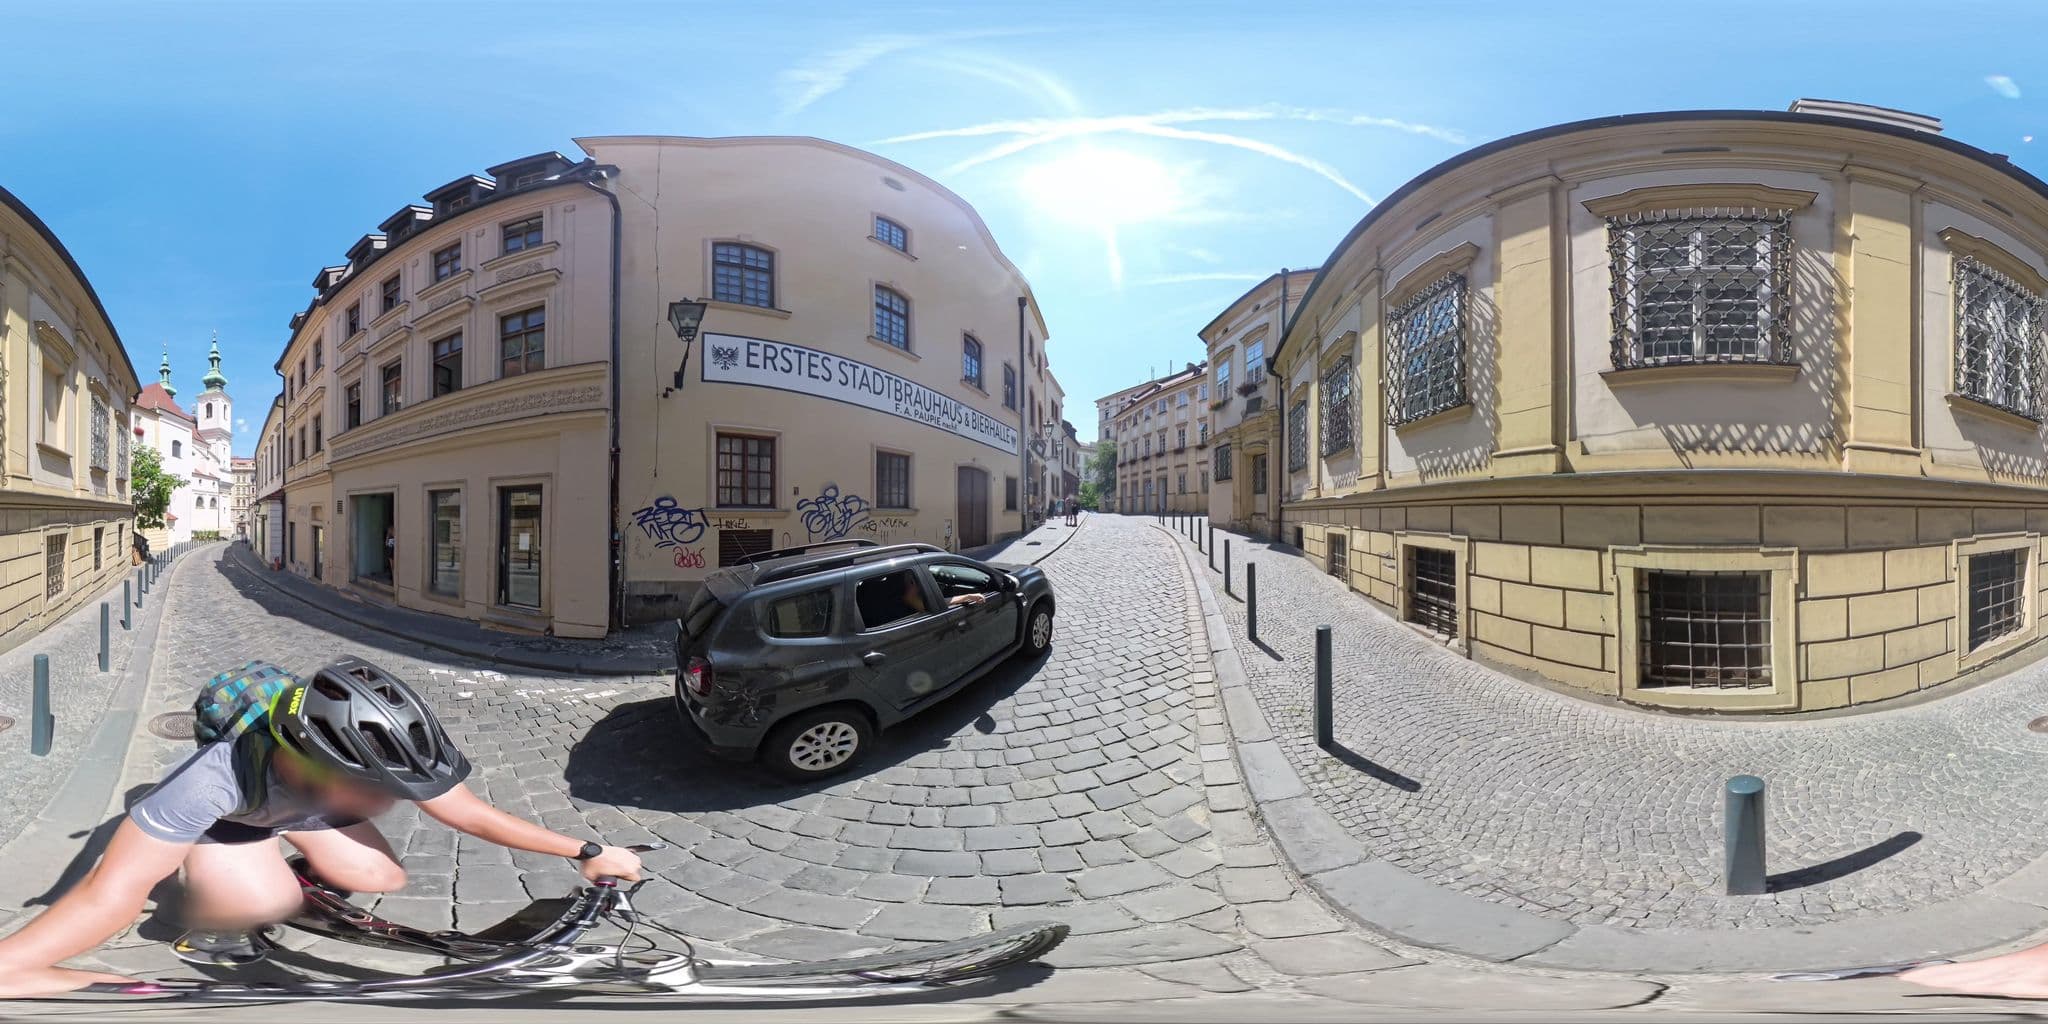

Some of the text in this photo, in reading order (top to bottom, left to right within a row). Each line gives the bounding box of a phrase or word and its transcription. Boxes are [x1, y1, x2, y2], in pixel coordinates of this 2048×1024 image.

[746, 341, 1011, 445] ERSTES STADTBRAUHAUS & BIERHALLE
[895, 403, 902, 413] F.
[904, 406, 912, 417] A.
[914, 409, 941, 426] PAUPIE
[288, 687, 304, 715] uvex
